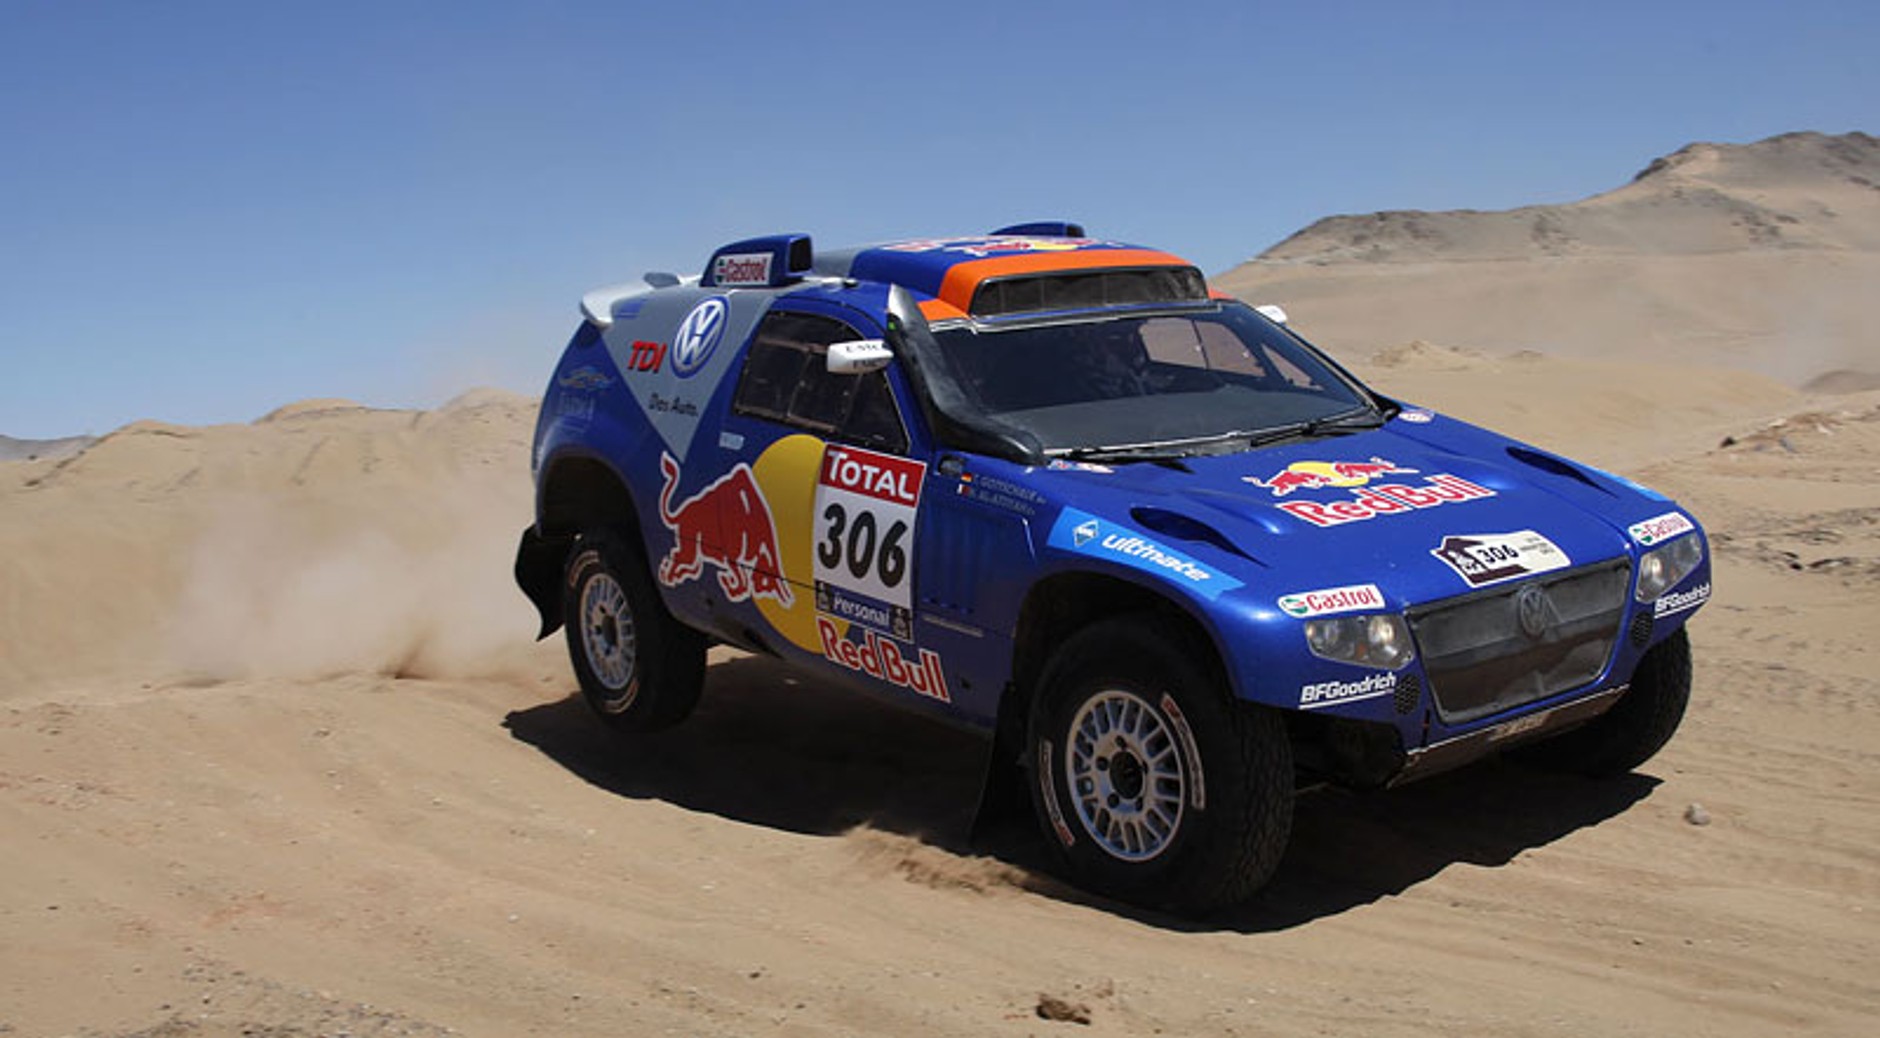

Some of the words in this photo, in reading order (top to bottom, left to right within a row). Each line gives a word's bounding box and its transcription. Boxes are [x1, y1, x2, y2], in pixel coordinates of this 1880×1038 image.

[726, 257, 768, 283] Castrol
[627, 340, 667, 373] TDI
[649, 393, 669, 411] Das
[826, 450, 916, 501] TOTAL
[1644, 515, 1688, 537] Castrol
[817, 502, 908, 589] 306
[1101, 534, 1211, 581] ultimate
[1476, 544, 1519, 563] 306
[833, 591, 893, 626] Personal
[1306, 587, 1379, 611] Castrol
[1655, 583, 1710, 613] BFGoodrich
[817, 617, 884, 680] Red
[878, 639, 951, 704] Bull
[1300, 671, 1397, 703] BFGoodrich
